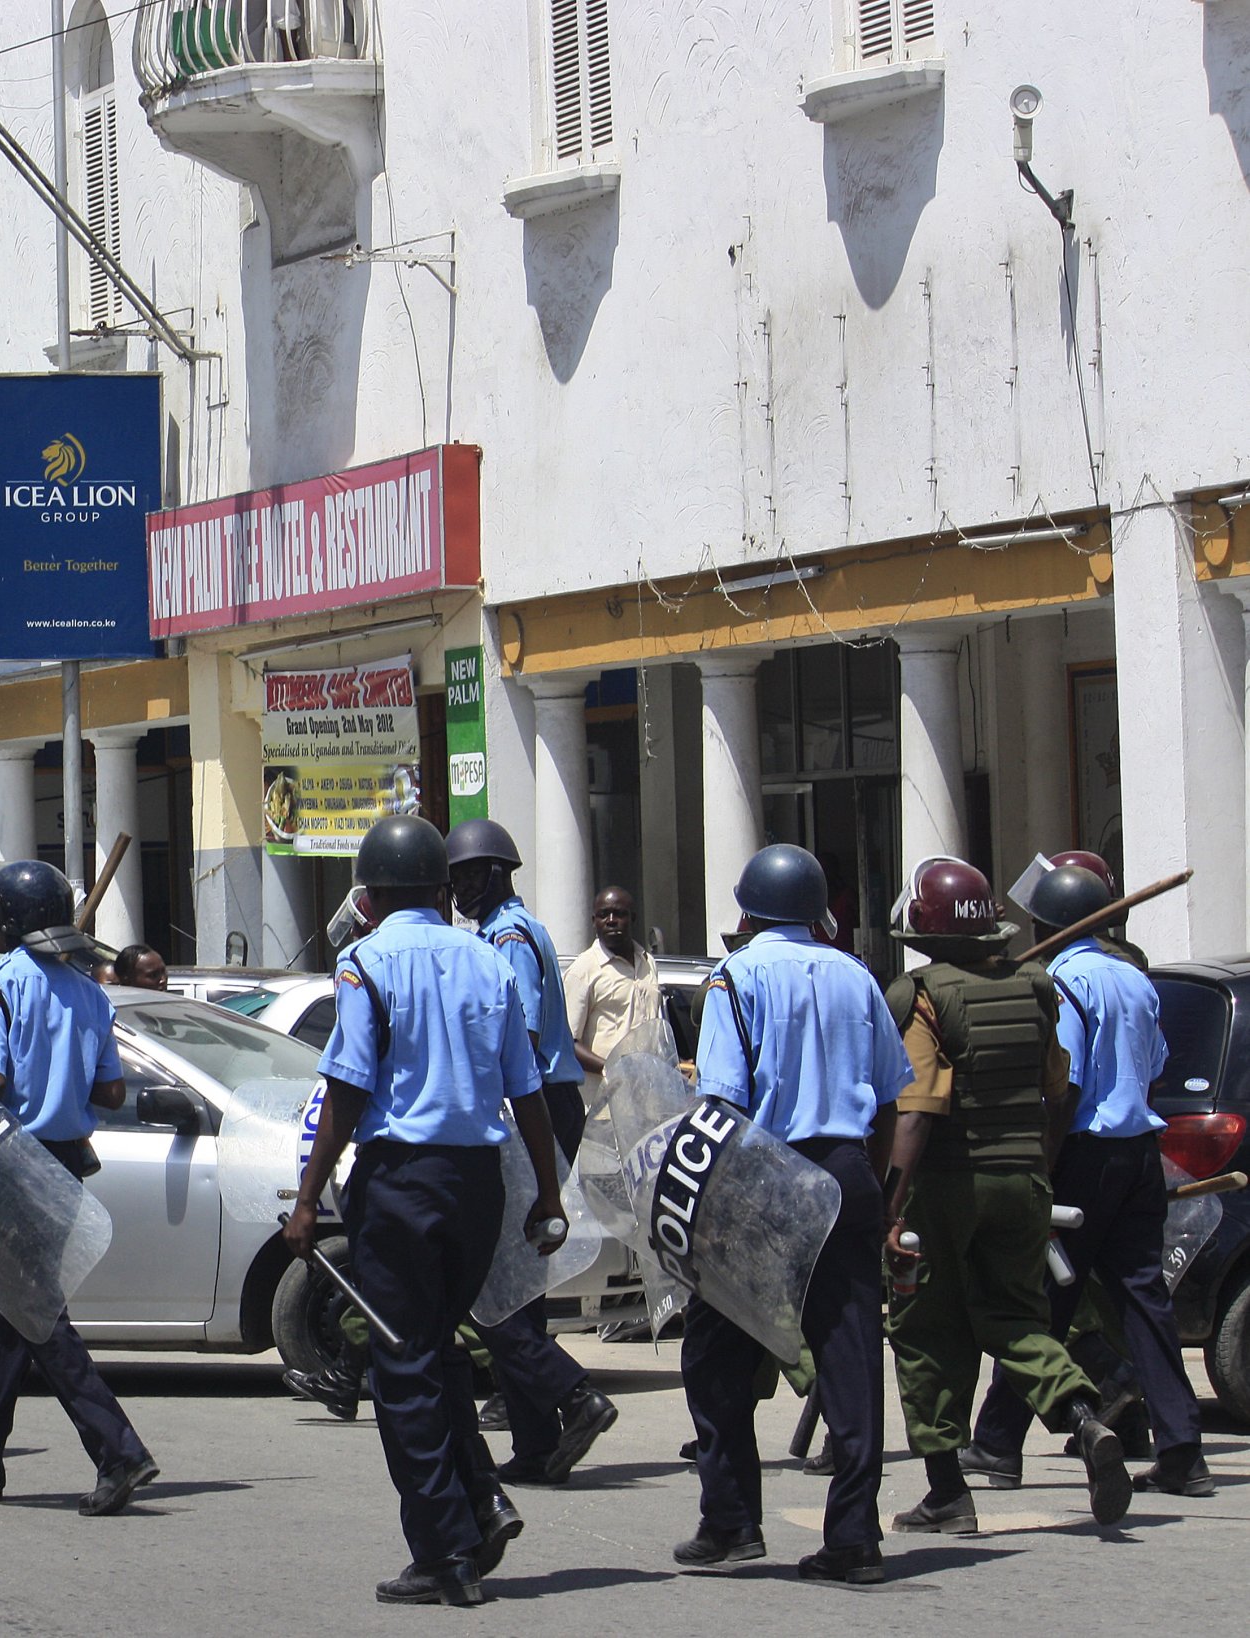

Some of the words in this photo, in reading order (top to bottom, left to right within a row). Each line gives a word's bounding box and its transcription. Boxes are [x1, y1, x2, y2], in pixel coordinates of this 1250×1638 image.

[5, 486, 66, 507] ICEA
[73, 486, 136, 507] LION
[41, 512, 100, 523] GROUP
[150, 525, 182, 621] NEW
[184, 517, 223, 615] PALM
[223, 509, 260, 608] TREE
[260, 499, 309, 601] HOTEL
[310, 510, 324, 595] &
[324, 469, 432, 591] RESTAURANT
[23, 559, 61, 572] Better
[65, 559, 119, 573] Together
[451, 658, 476, 681] NEW
[447, 681, 479, 706] PALM
[286, 717, 307, 735] Grand
[308, 717, 340, 738] Opening
[341, 716, 357, 733] 2nd
[358, 714, 374, 737] May
[376, 713, 395, 733] 2012
[301, 743, 309, 757] in
[310, 742, 341, 761] Ugandan
[341, 741, 354, 756] and
[656, 1101, 736, 1291] POLICE
